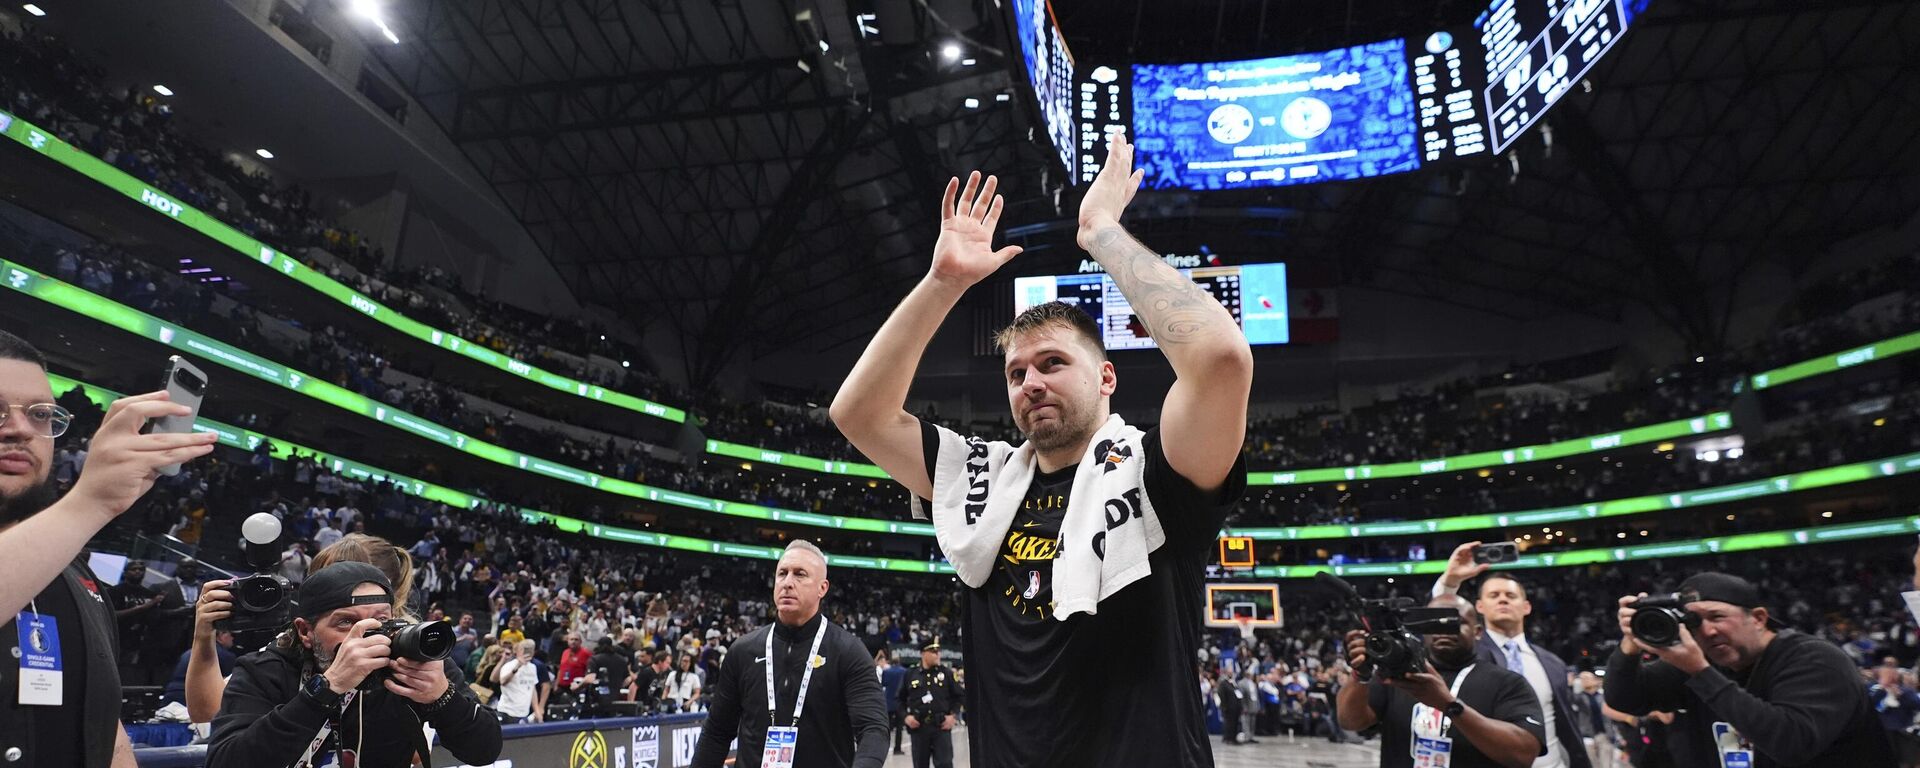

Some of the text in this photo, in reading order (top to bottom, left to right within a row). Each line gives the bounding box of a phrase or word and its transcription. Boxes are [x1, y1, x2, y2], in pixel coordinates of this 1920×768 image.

[141, 188, 183, 218] HOT
[351, 294, 378, 316] HOT
[508, 359, 531, 376] HOT
[645, 403, 666, 417] HOT
[761, 451, 782, 463] HOT
